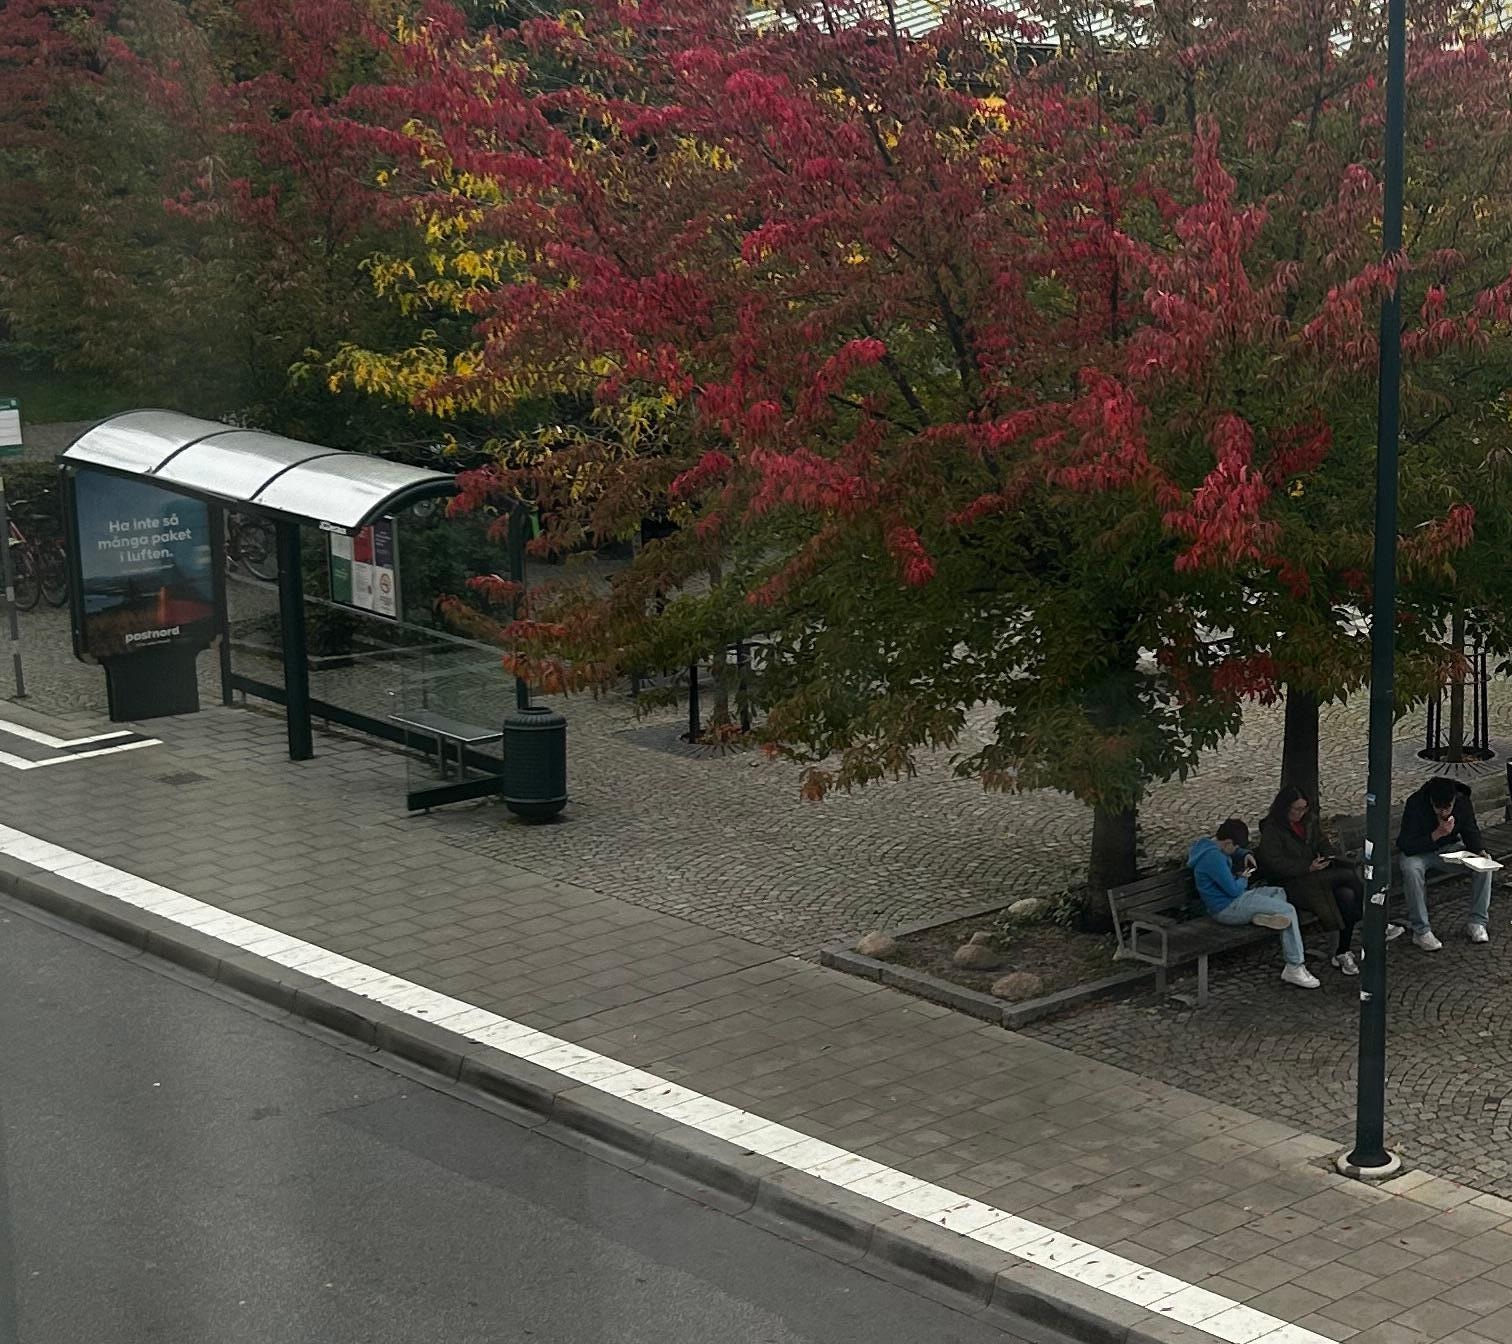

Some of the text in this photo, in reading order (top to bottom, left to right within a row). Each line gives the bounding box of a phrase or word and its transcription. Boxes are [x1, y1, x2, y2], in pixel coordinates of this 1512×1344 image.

[108, 513, 179, 533] Ha inte så
[97, 528, 192, 550] många paket
[127, 548, 174, 562] luften.
[125, 626, 180, 644] postnord
